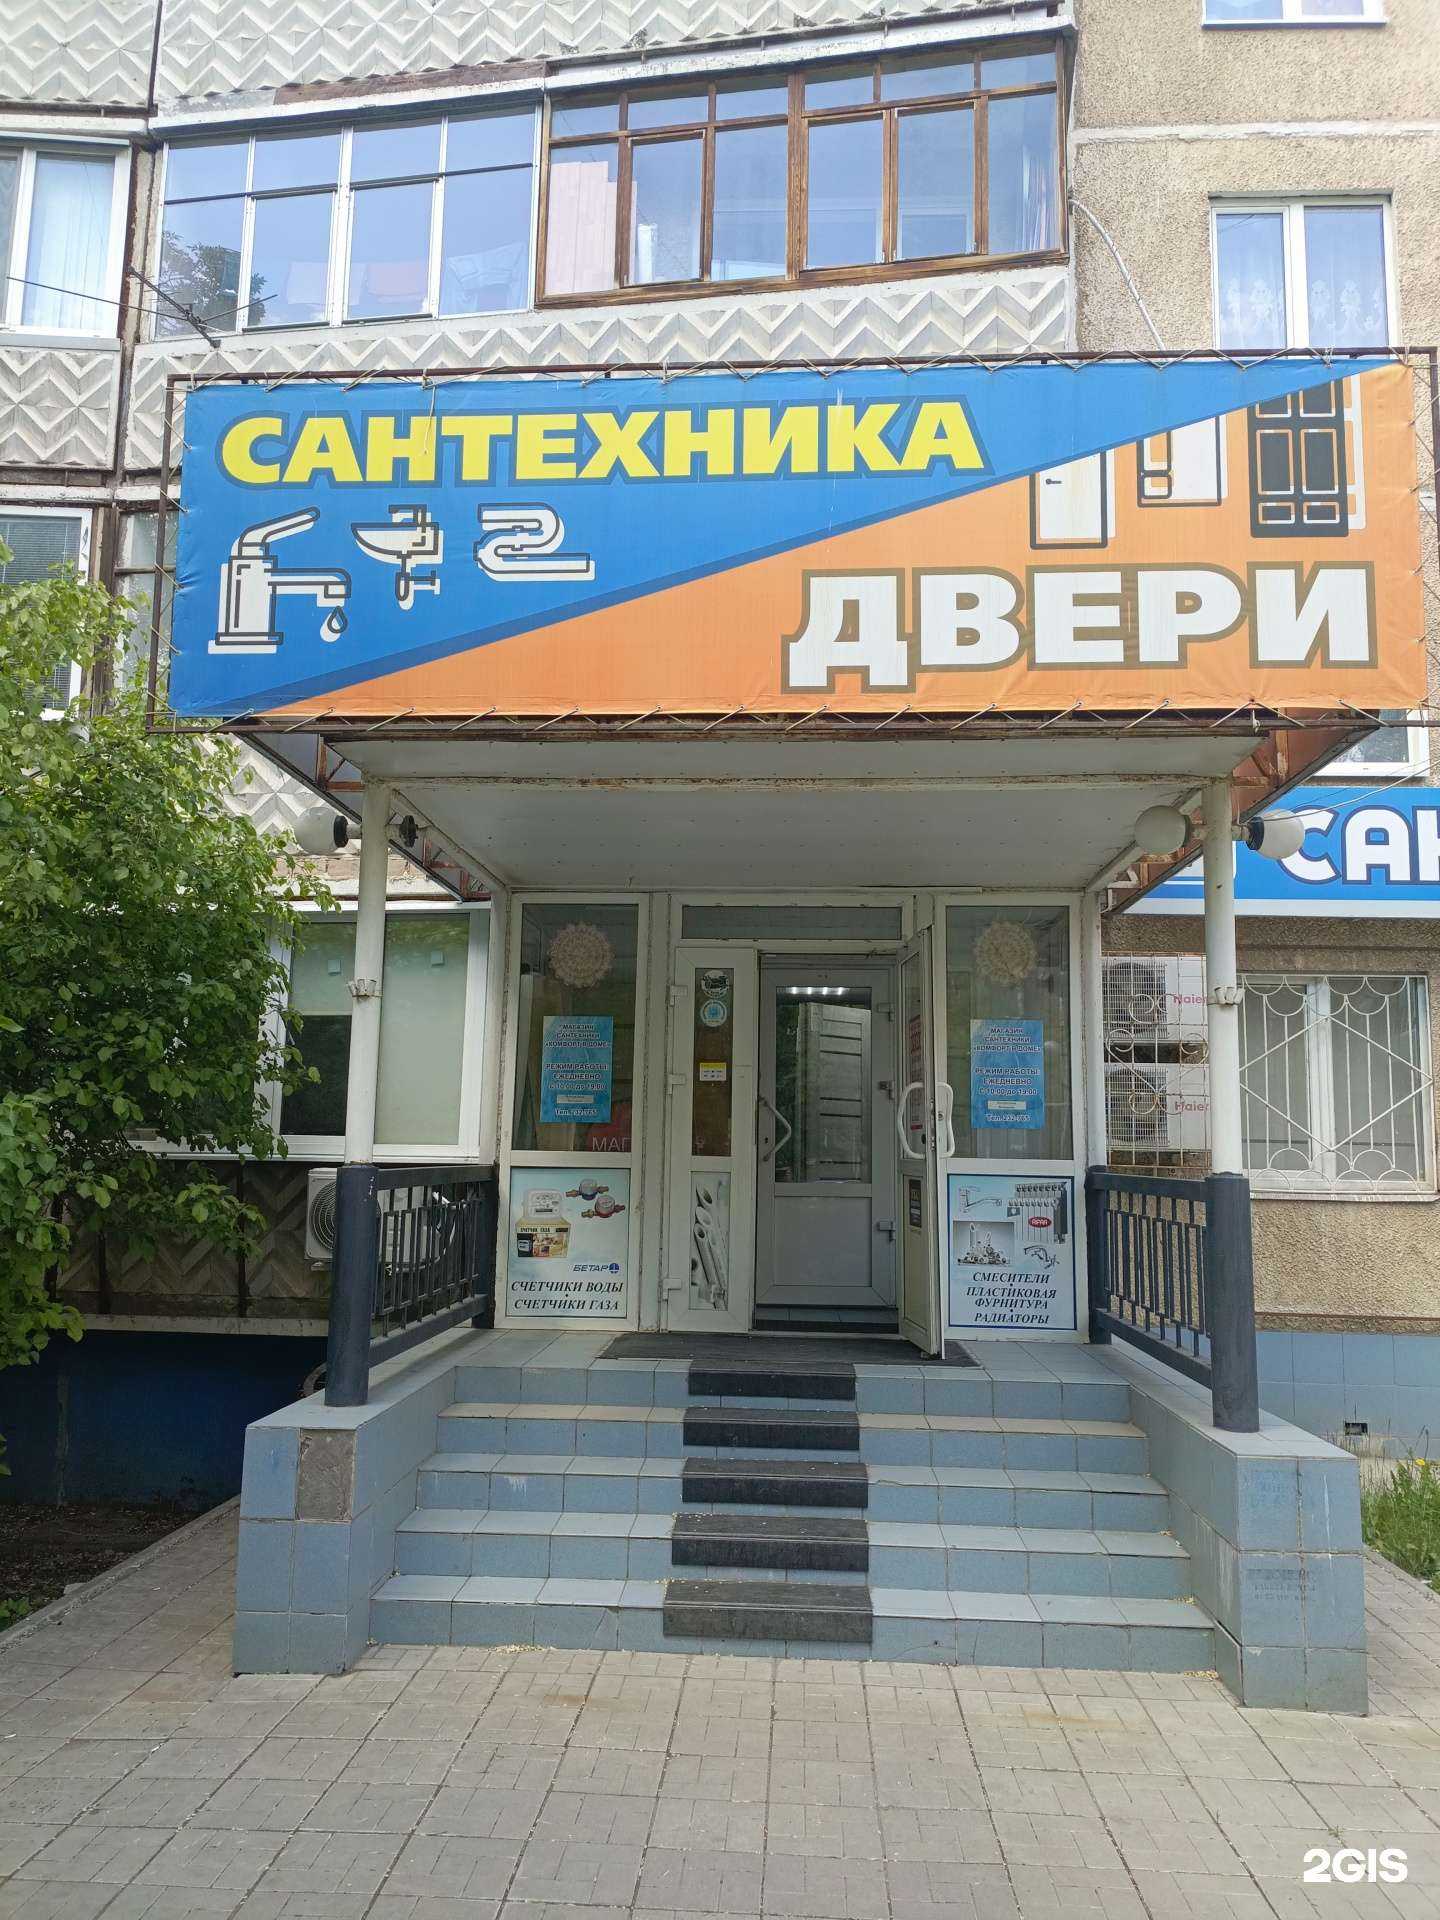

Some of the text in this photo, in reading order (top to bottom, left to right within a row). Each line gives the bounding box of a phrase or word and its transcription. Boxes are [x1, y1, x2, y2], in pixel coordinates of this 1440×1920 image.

[218, 399, 988, 487] САНТЕХНИКА
[786, 566, 1375, 691] ДВЕРИ
[1174, 1101, 1210, 1112] Haier
[573, 1264, 609, 1272] БЕТАР
[972, 1272, 1050, 1284] СМЕСИТЕЛИ
[511, 1281, 624, 1293] СЧЕТЧИКИ ВОДЫ
[966, 1287, 1057, 1299] ПЛАСТИКОВАЯ
[514, 1299, 619, 1311] СЧЕТЧИКИ ГАЗА
[975, 1298, 1048, 1310] ФУРНИТУРА
[974, 1312, 1050, 1325] РАДИАТОРЫ
